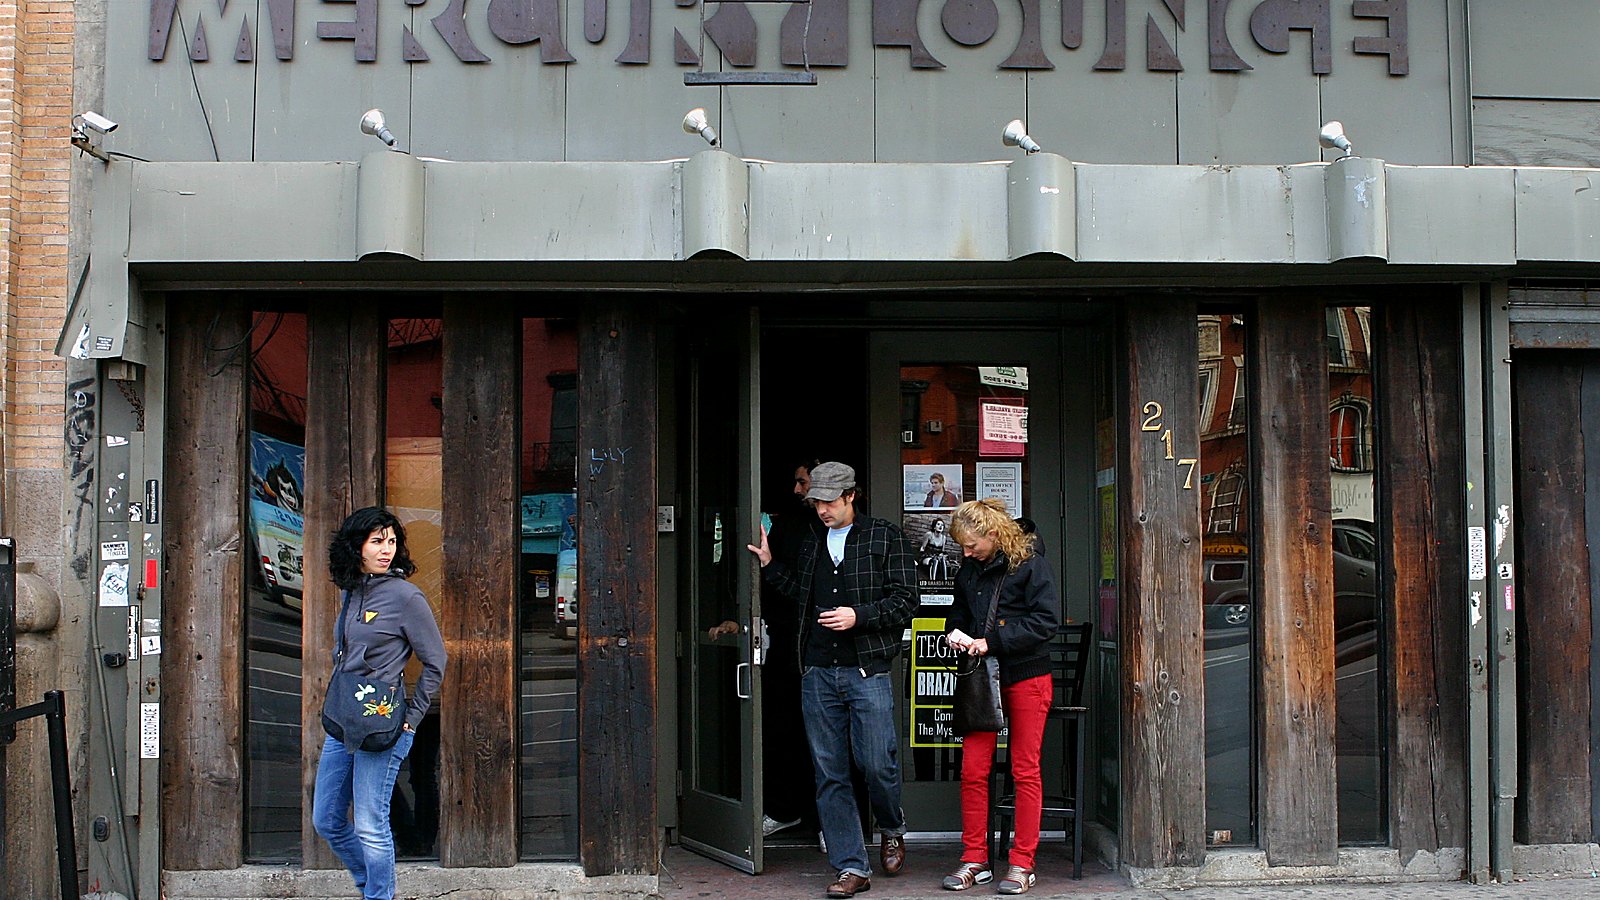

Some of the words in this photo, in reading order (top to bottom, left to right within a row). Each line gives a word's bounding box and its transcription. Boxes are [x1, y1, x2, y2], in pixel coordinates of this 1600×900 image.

[148, 0, 848, 67] MERCURY
[868, 0, 1410, 75] LOUNGE
[1141, 401, 1198, 490] 217
[917, 634, 960, 658] TEGA
[917, 672, 957, 696] BRAZI
[918, 723, 934, 736] The
